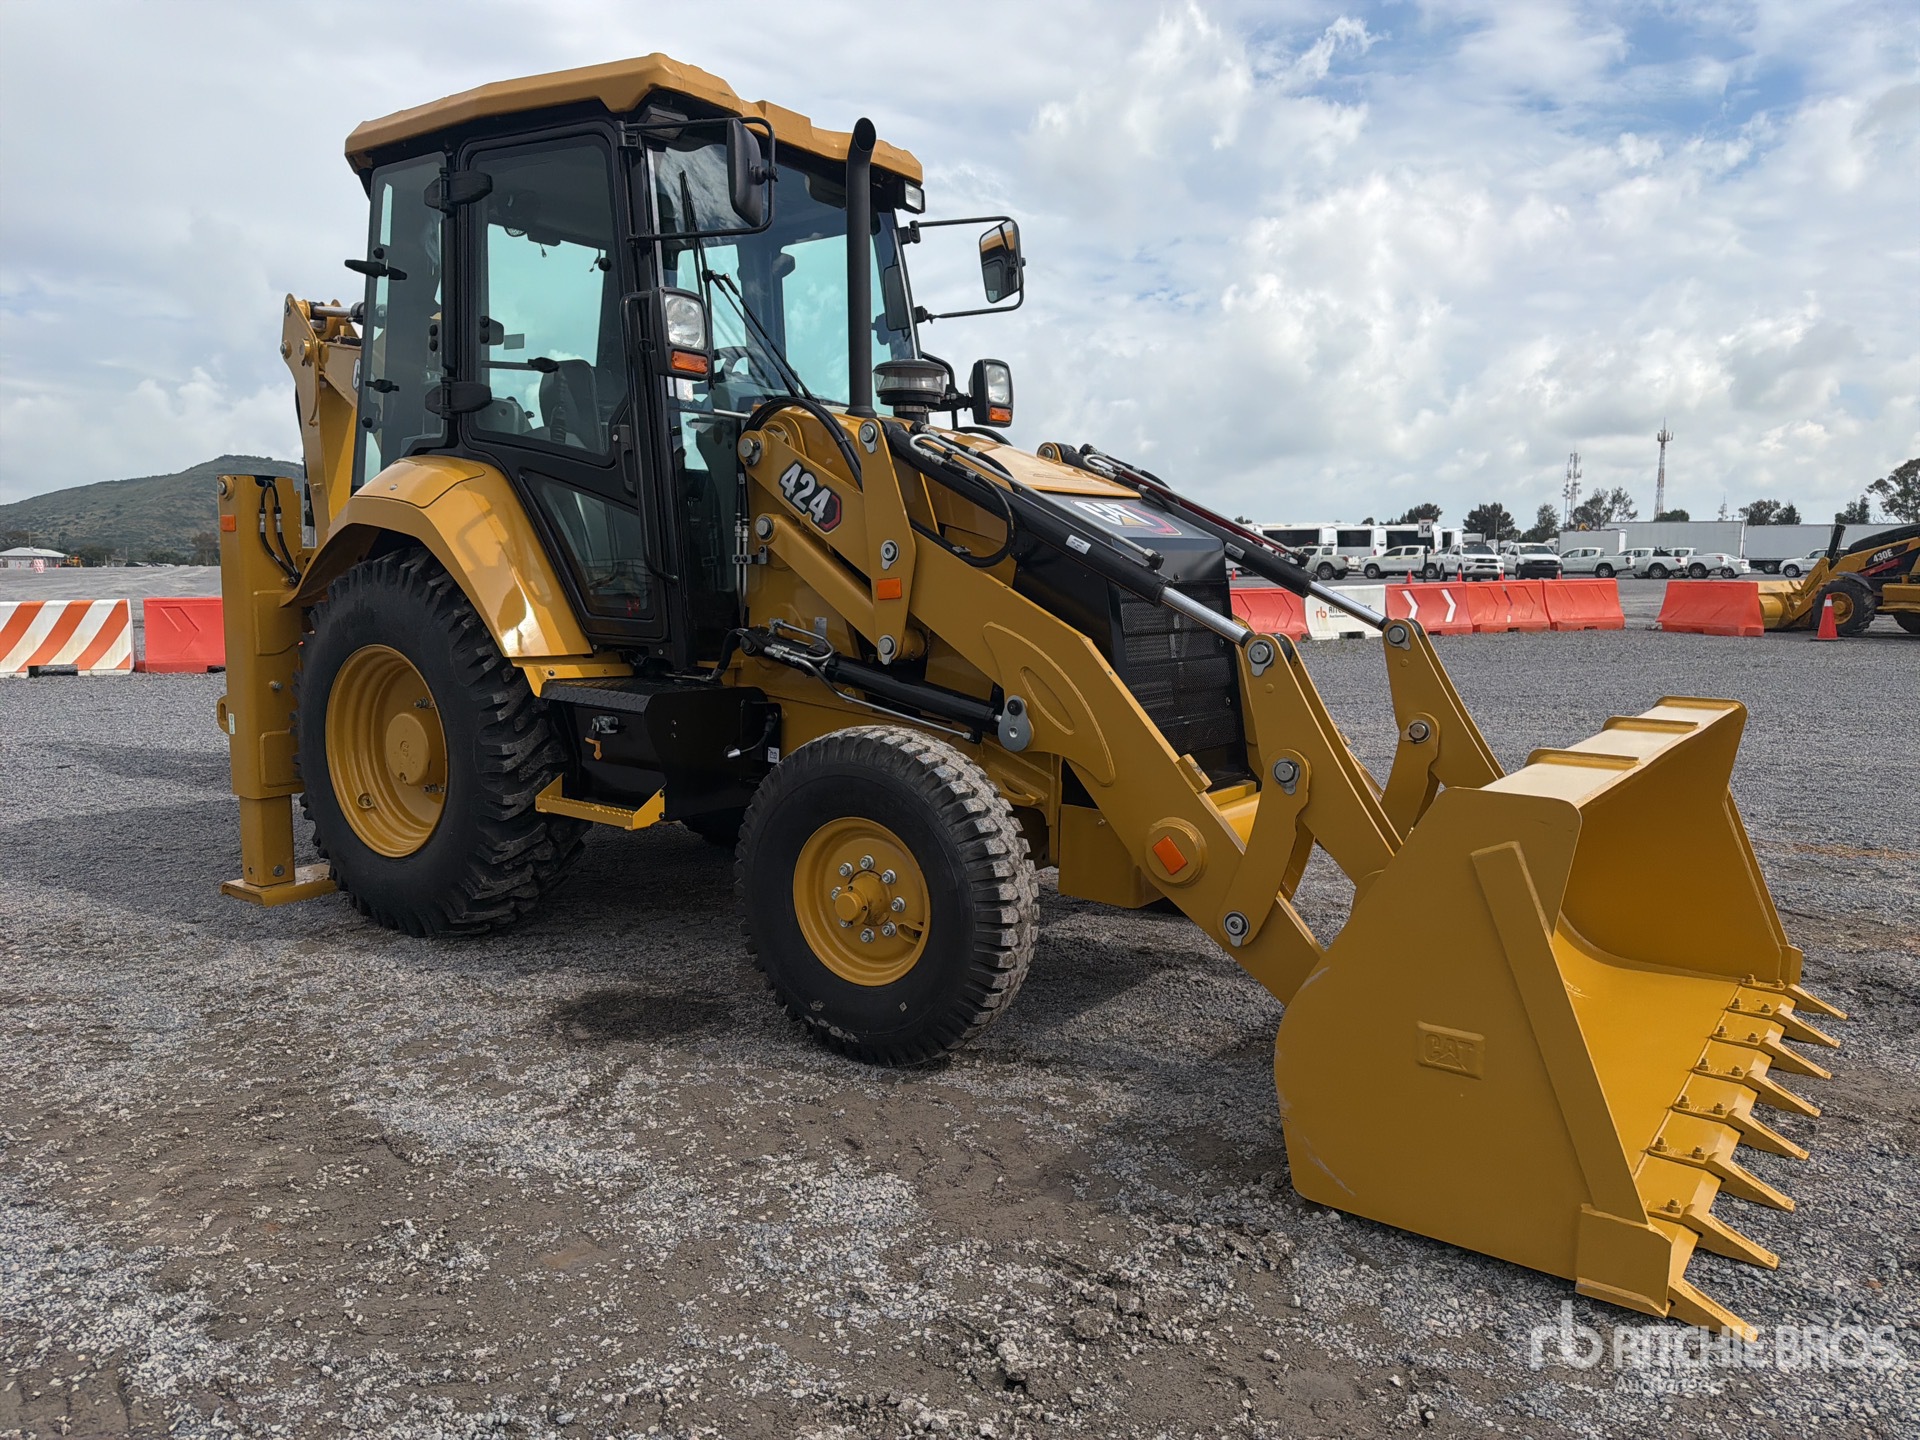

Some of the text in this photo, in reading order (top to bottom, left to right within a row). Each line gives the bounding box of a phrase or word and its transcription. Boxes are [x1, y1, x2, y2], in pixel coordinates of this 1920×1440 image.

[780, 462, 832, 524] 424
[1072, 500, 1157, 529] CAT
[1420, 525, 1431, 534] 14
[1873, 548, 1894, 563] 430E
[1315, 606, 1327, 619] rb
[1424, 1033, 1475, 1073] CAT
